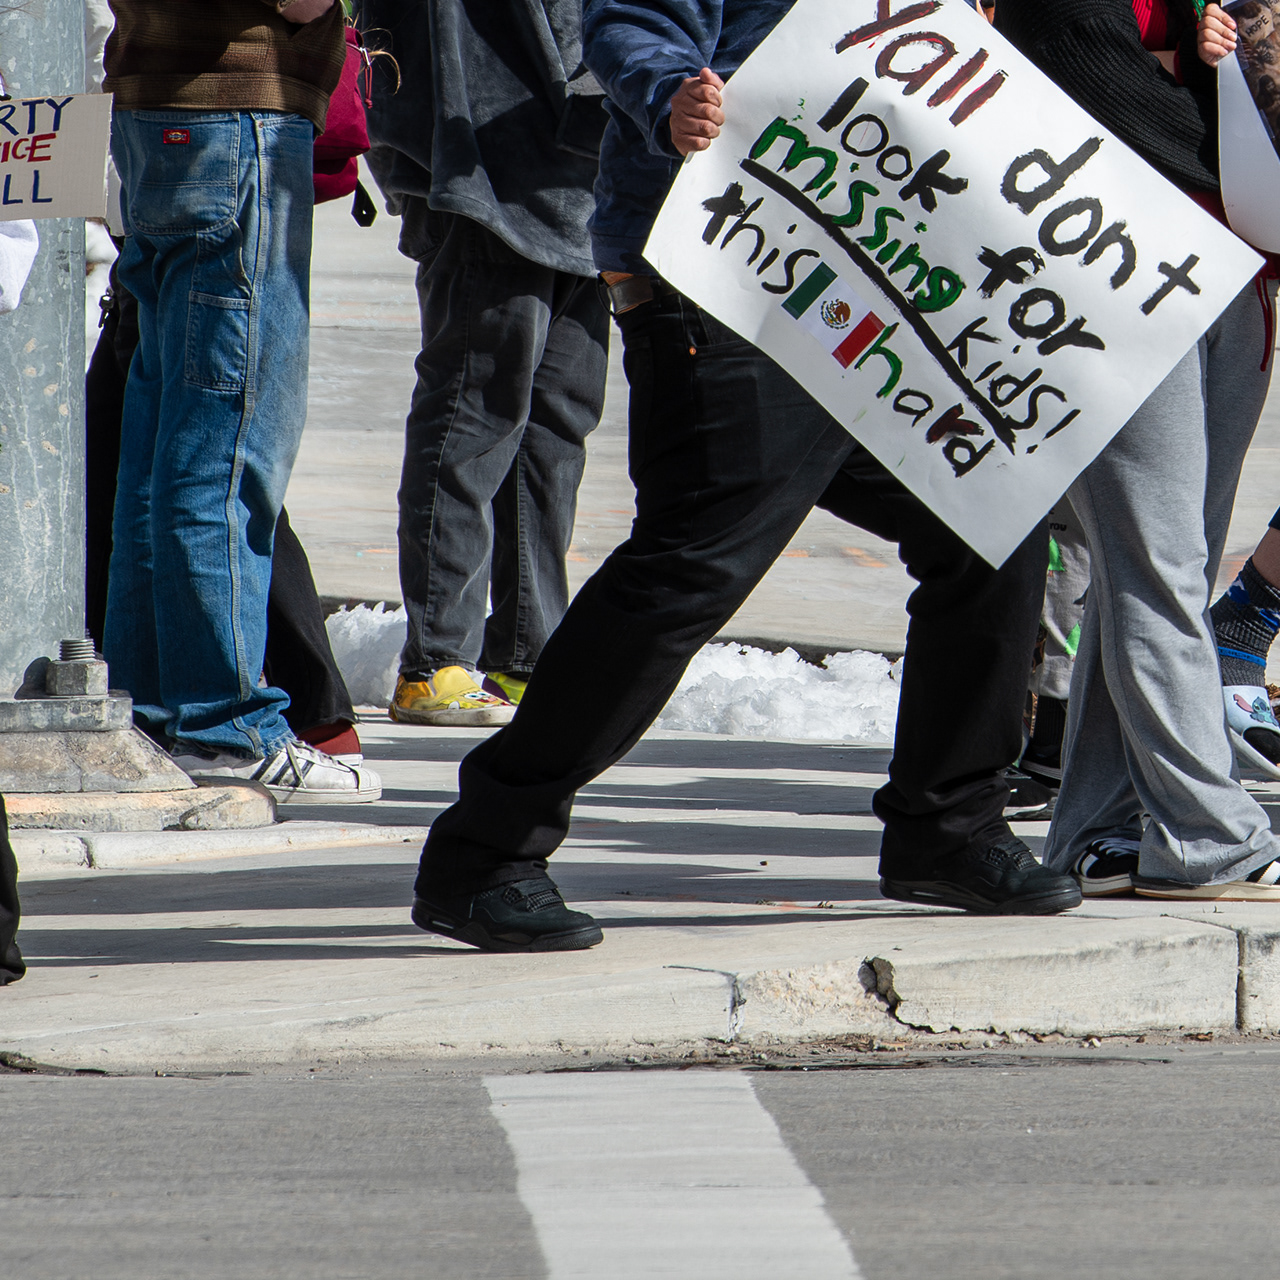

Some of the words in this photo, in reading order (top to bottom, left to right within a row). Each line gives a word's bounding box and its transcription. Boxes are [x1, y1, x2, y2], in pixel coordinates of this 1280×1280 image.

[1244, 14, 1270, 37] HOPE
[700, 181, 821, 296] this
[854, 320, 998, 478] hard
[750, 115, 967, 313] missing
[816, 76, 969, 214] look
[977, 244, 1106, 356] for
